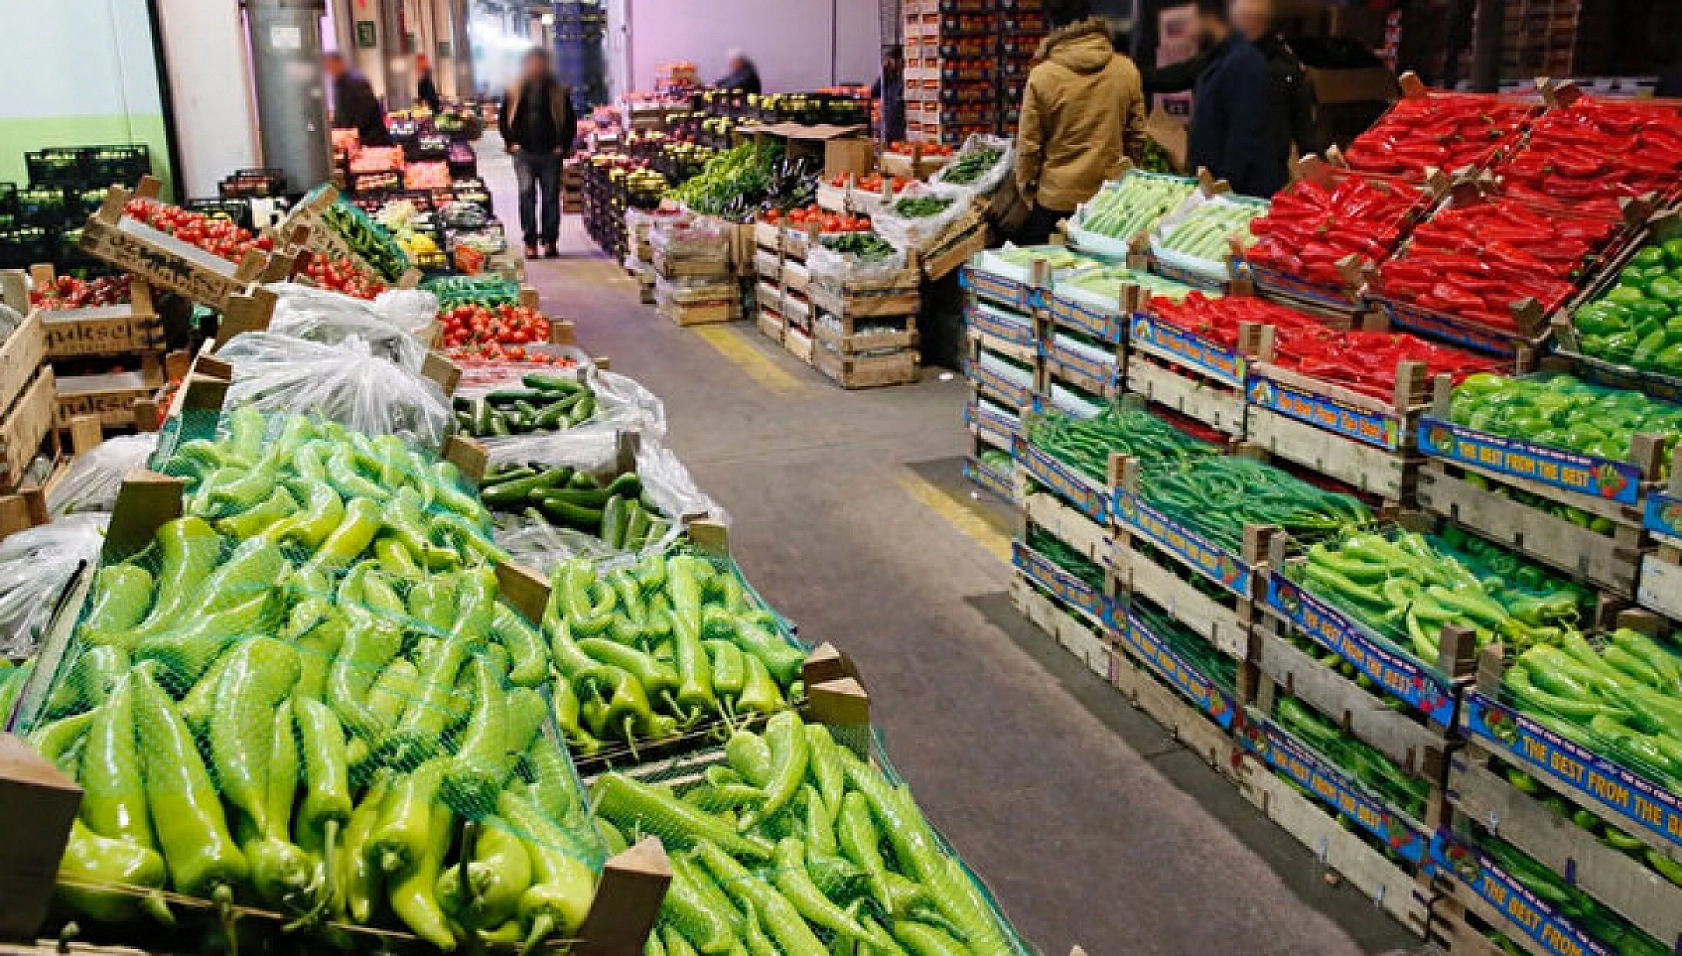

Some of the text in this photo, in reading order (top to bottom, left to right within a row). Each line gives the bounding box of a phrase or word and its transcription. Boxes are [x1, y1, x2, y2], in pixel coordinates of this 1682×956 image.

[1458, 442, 1476, 459] THE
[1480, 446, 1503, 465] BEST
[1505, 453, 1535, 474] FROM
[1539, 460, 1558, 480] THE
[1561, 467, 1589, 487] BEST
[1384, 668, 1413, 695] BEST
[1523, 735, 1547, 762] THE
[1551, 751, 1586, 783] BEST
[1587, 770, 1629, 808] FROM
[1634, 793, 1662, 826] THE
[1484, 875, 1507, 905] THE
[1509, 897, 1541, 930] BEST
[1542, 922, 1583, 956] FROM
